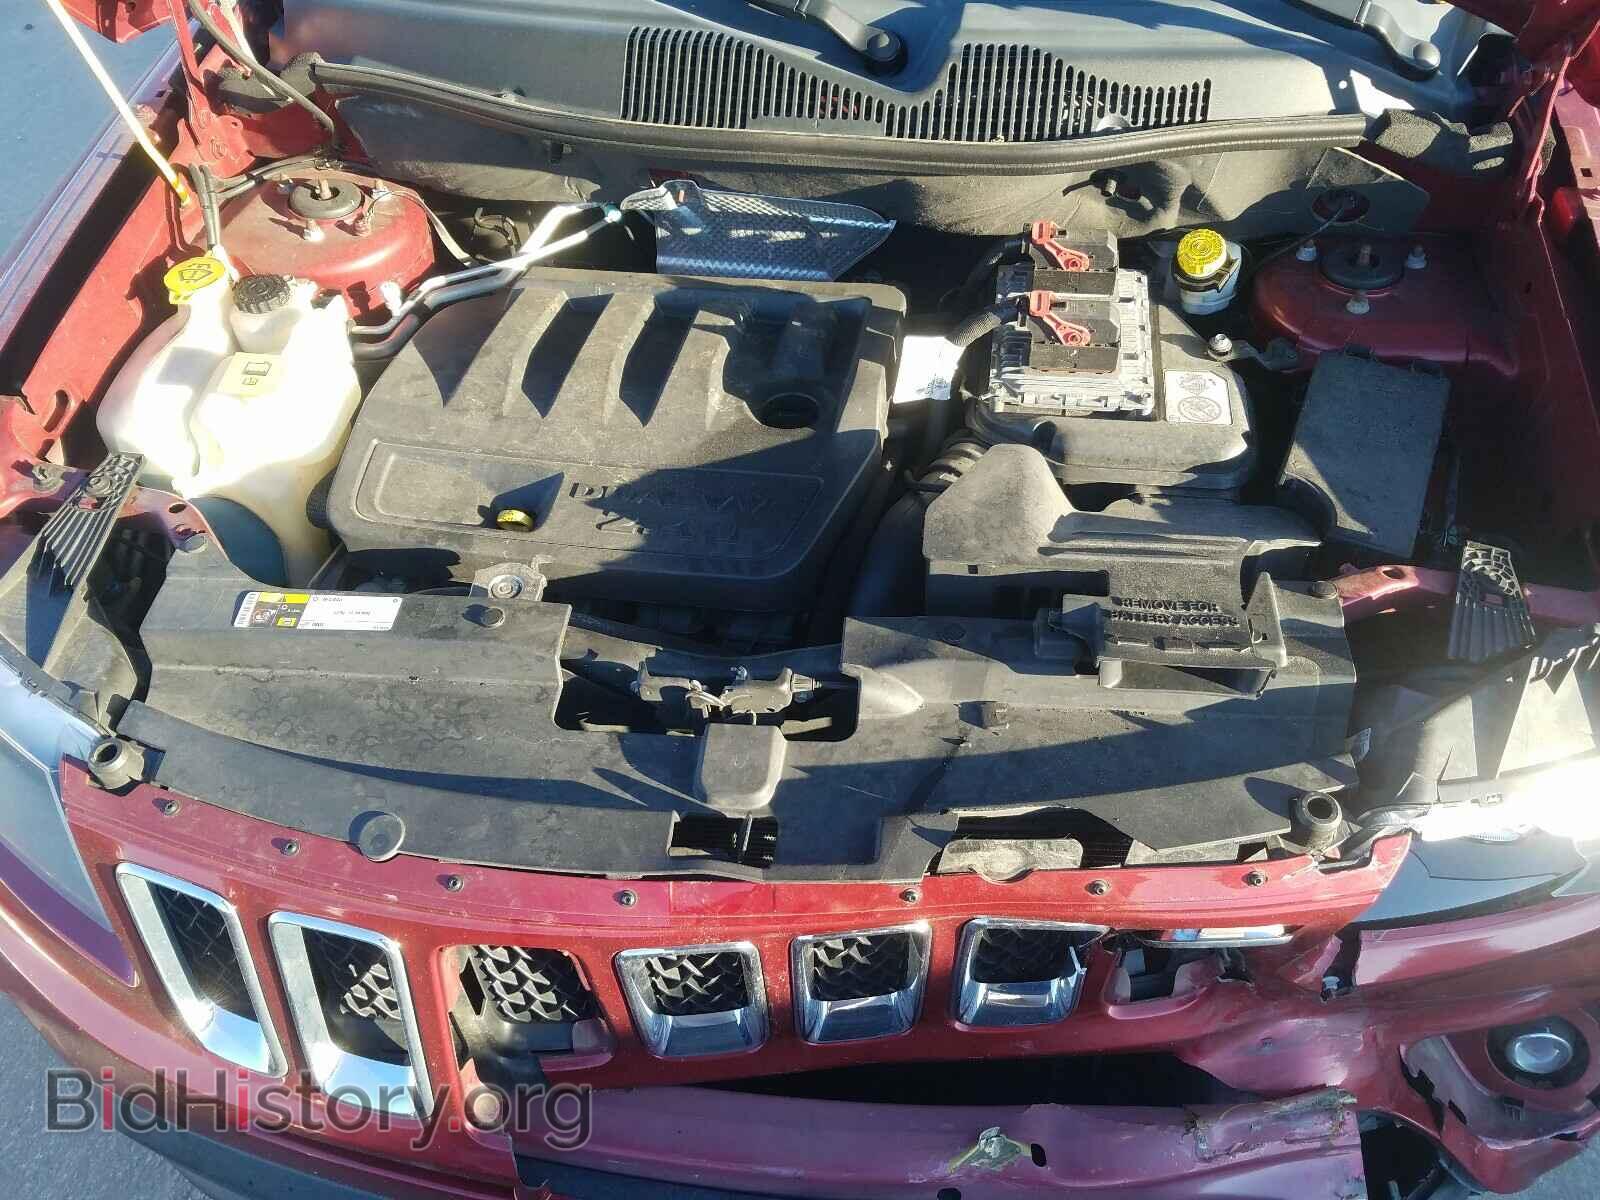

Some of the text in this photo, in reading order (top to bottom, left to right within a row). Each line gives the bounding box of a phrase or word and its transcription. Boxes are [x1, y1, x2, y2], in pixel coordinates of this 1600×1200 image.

[1120, 597, 1218, 613] REMOVE FOR
[1111, 608, 1177, 626] BATTERY
